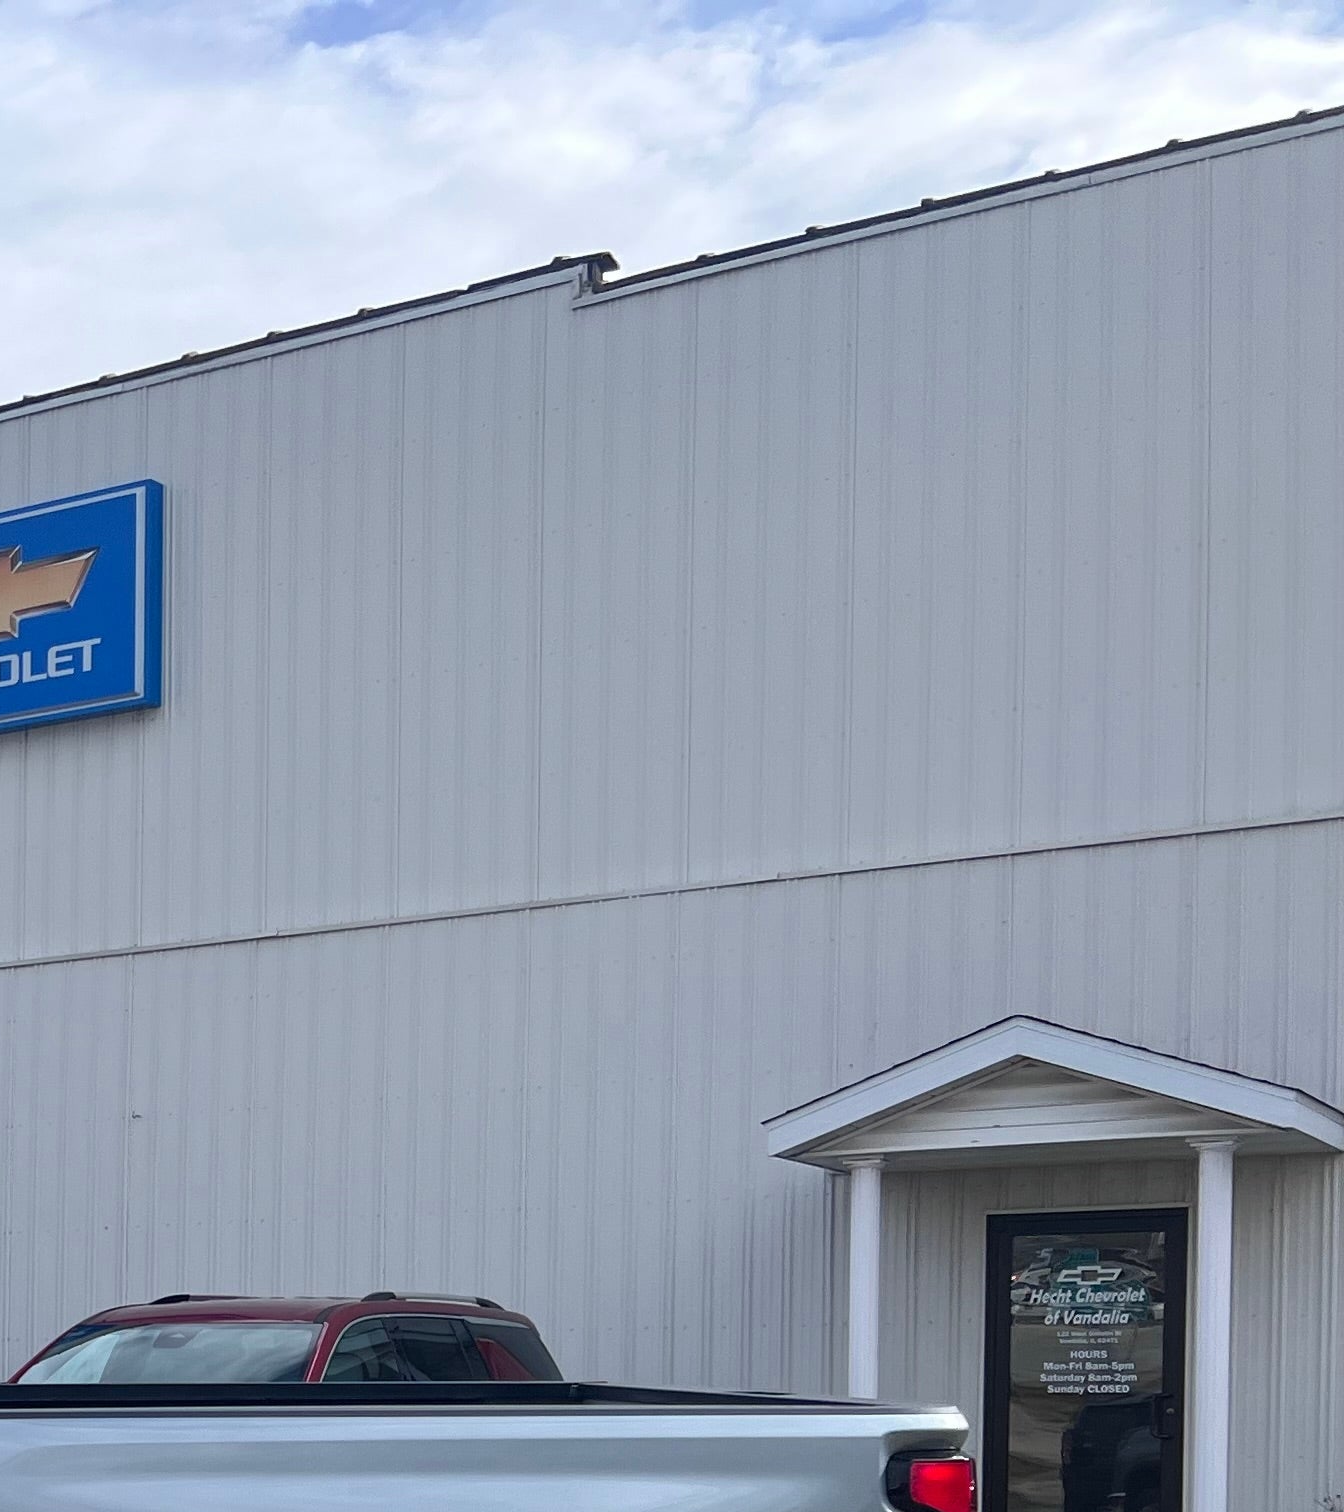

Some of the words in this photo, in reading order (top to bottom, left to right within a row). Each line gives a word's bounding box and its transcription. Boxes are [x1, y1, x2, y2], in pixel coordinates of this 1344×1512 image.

[1029, 1288, 1072, 1305] Hecht
[1075, 1286, 1146, 1304] Chevrolet
[1044, 1309, 1062, 1326] of
[1063, 1309, 1130, 1326] Vandalia
[1070, 1350, 1108, 1359] HOURS
[1043, 1361, 1083, 1371] Mon-Fri
[1085, 1361, 1135, 1371] 8am-5pm
[1039, 1373, 1086, 1383] Saturday
[1087, 1373, 1138, 1383] 8am-2pm
[1047, 1384, 1085, 1395] Sunday
[1087, 1384, 1130, 1394] CLOSED
